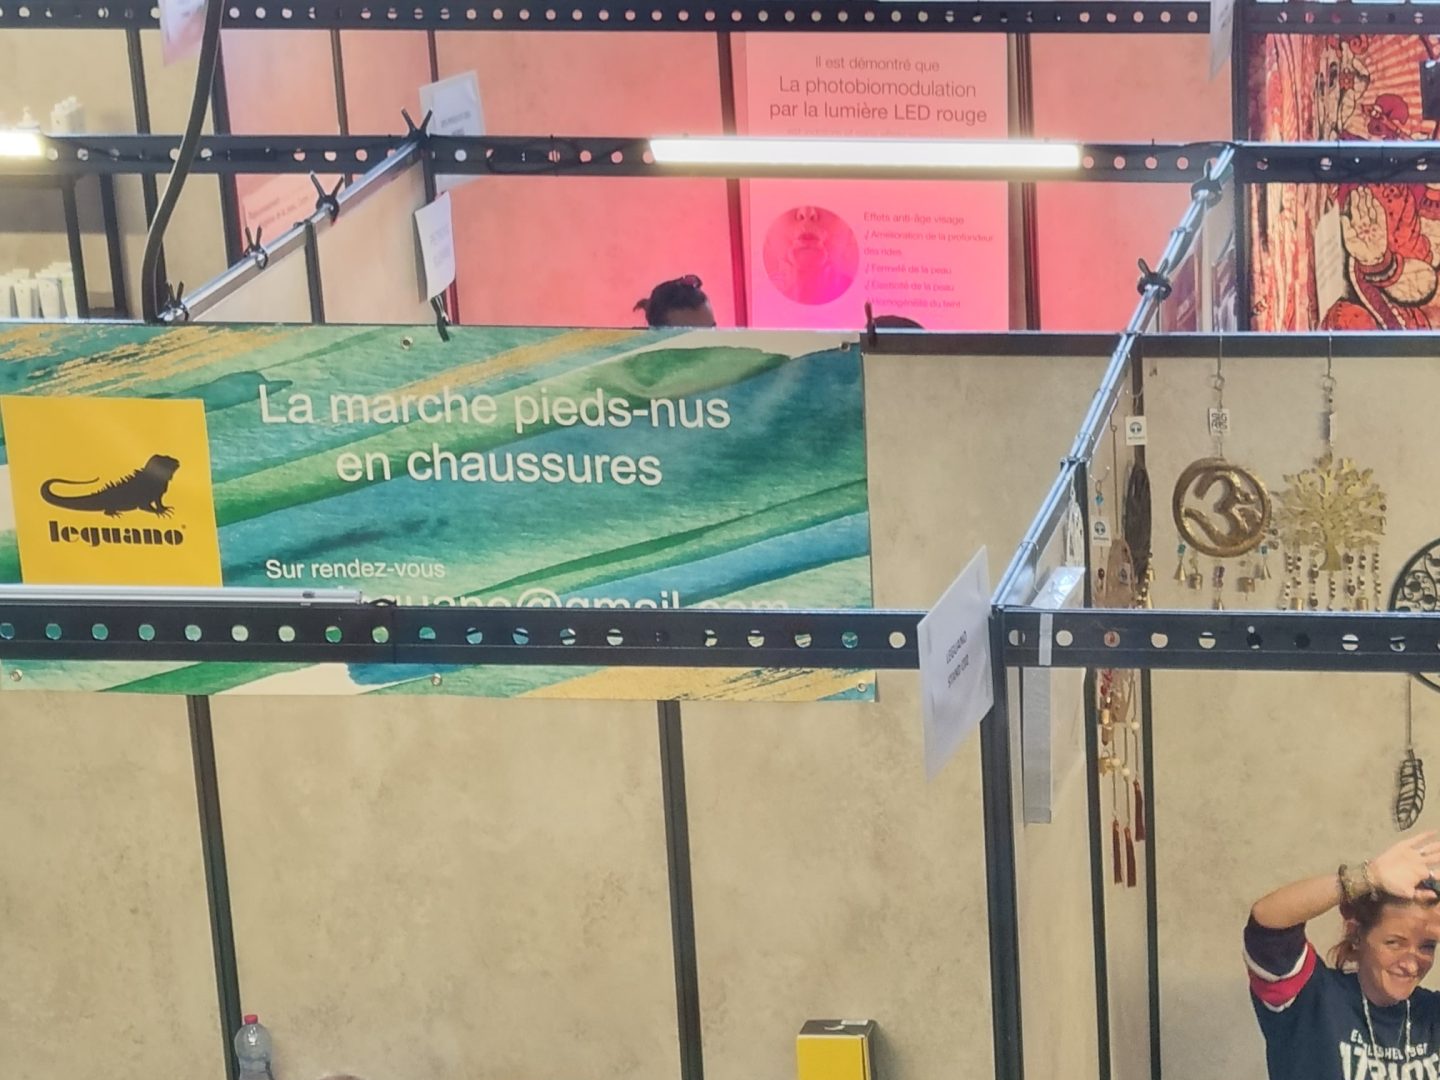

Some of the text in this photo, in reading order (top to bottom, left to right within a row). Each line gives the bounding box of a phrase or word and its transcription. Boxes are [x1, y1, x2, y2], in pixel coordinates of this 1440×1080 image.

[815, 55, 940, 74] Il est démontré que
[779, 75, 977, 99] La photobiomodulation
[769, 100, 988, 127] par la lumière LED rouge
[863, 211, 891, 223] Effets
[257, 383, 731, 434] La marche pieds-nus
[335, 442, 663, 487] en chaussures
[48, 520, 184, 548] leguano
[265, 558, 446, 580] Sur rendez-vous
